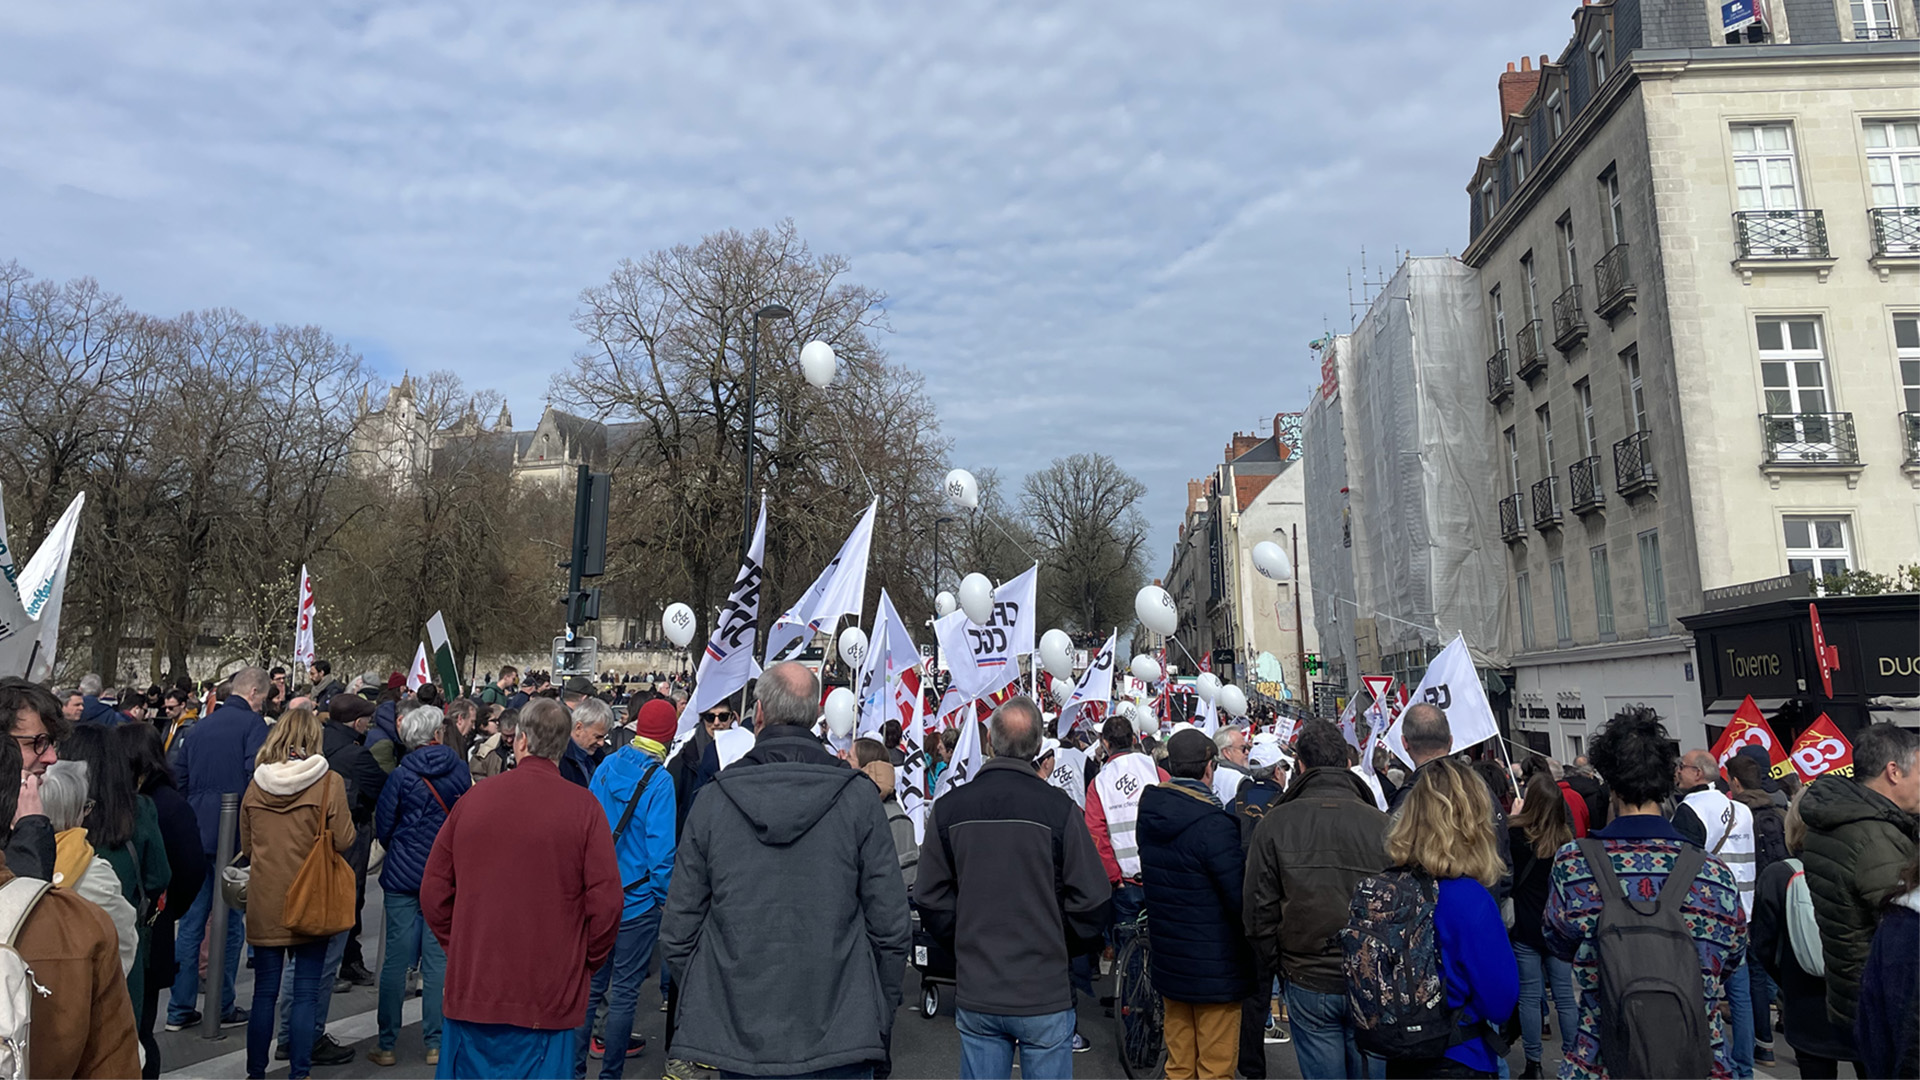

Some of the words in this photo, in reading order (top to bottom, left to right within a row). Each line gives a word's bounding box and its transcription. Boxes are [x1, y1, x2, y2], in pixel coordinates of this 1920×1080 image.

[671, 609, 683, 624] CFE
[853, 646, 864, 659] CC
[1815, 622, 1830, 679] TABAC
[1726, 649, 1780, 678] Taverne
[1131, 678, 1145, 691] FO
[1557, 702, 1586, 720] Restaurant
[1053, 764, 1067, 779] CFE
[1059, 769, 1074, 784] CGC
[1115, 773, 1129, 791] CFE
[1123, 777, 1139, 796] CGC
